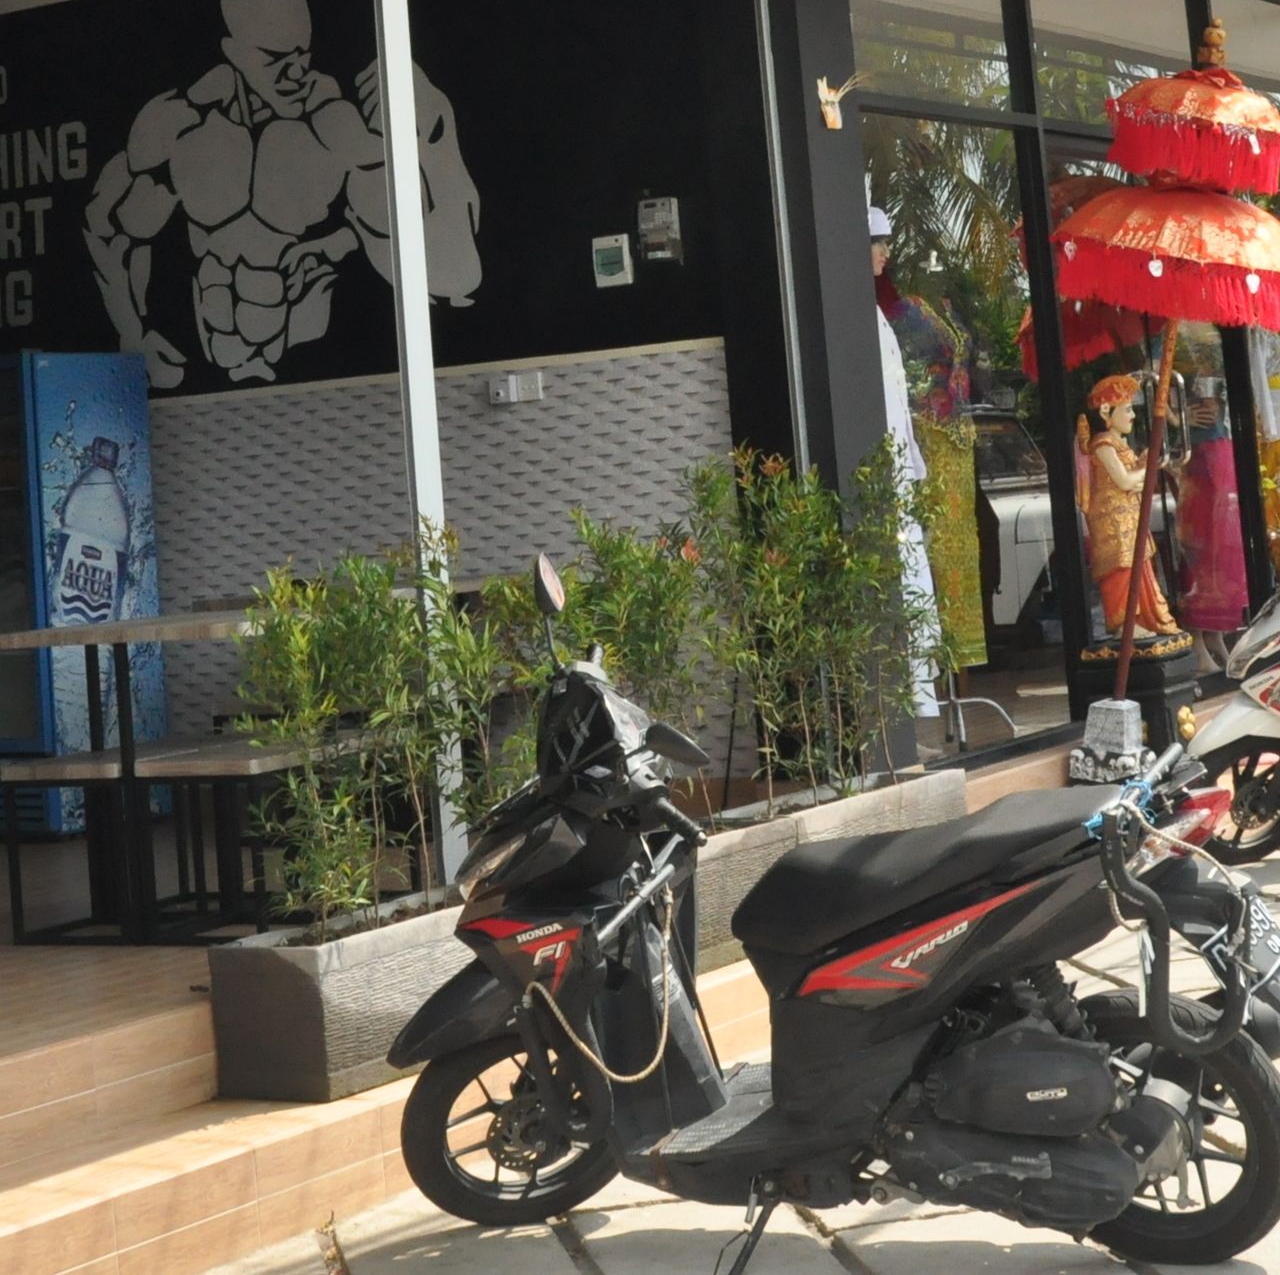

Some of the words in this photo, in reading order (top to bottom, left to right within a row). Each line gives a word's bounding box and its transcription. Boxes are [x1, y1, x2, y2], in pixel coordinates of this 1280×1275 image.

[61, 558, 113, 601] AQUA
[515, 922, 563, 944] HONDA
[532, 940, 567, 966] FI
